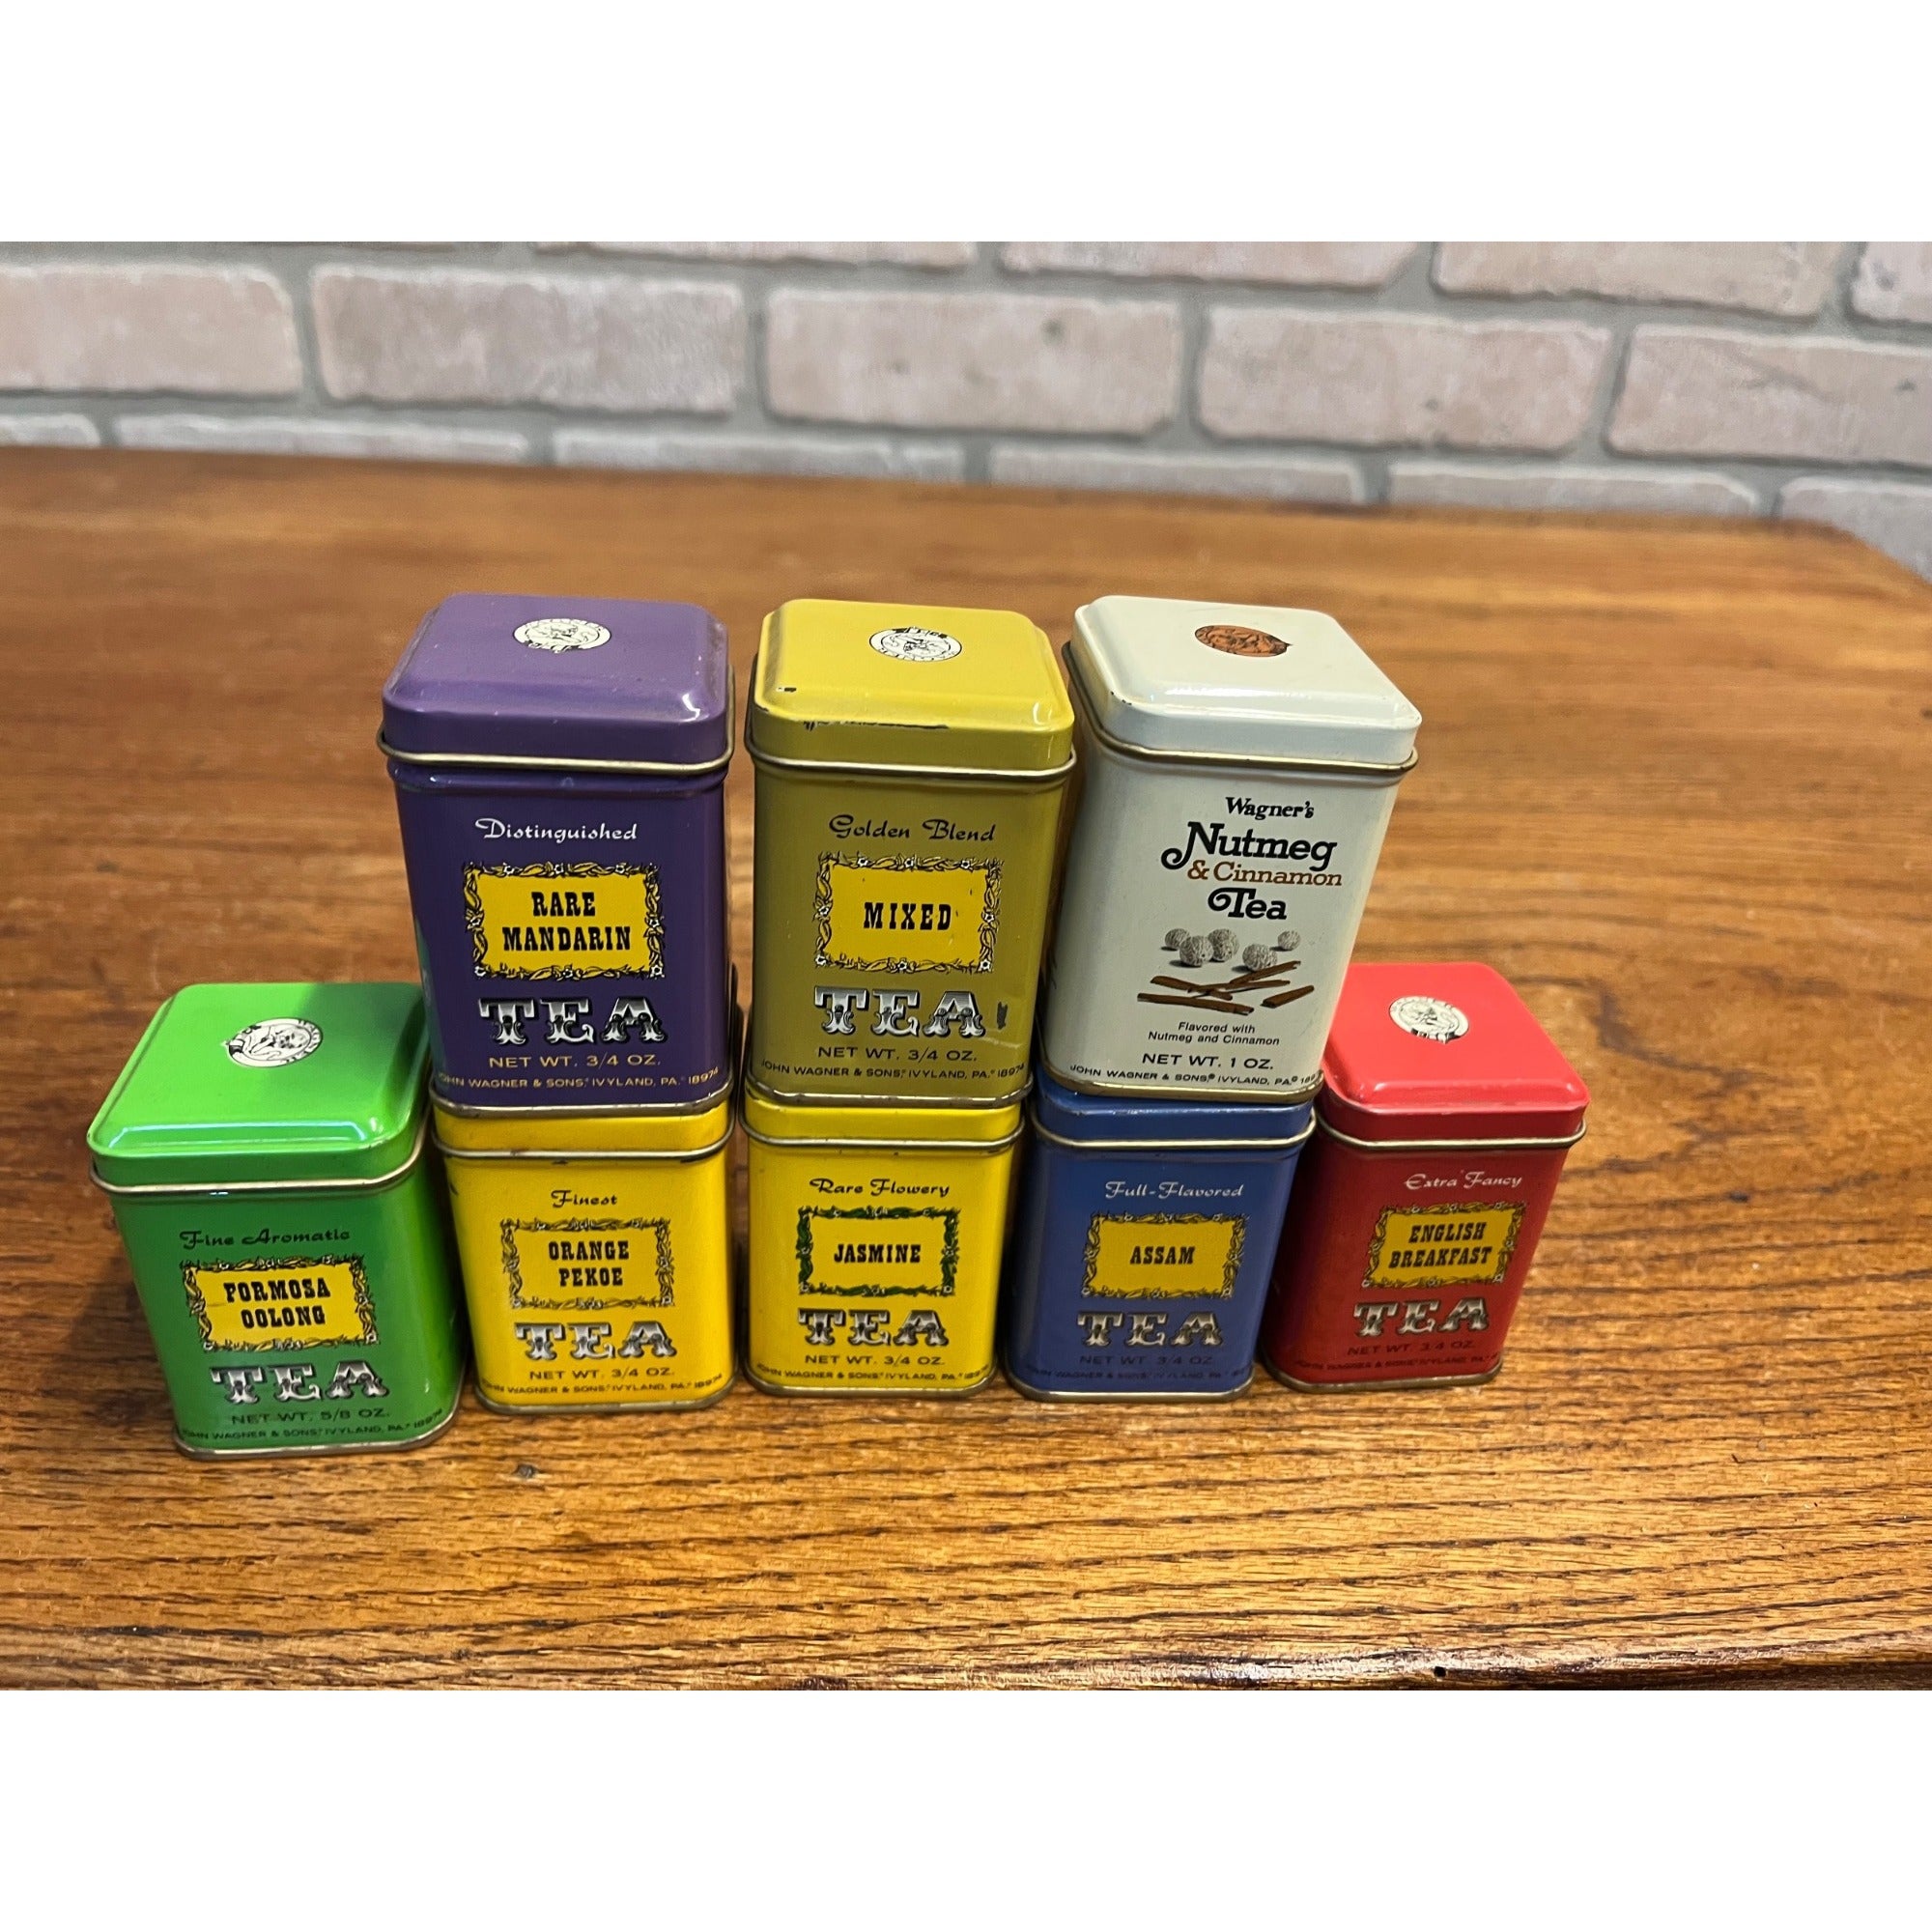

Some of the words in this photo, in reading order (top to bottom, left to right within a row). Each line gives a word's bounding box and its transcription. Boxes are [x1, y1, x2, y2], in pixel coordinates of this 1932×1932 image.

[1225, 797, 1315, 819] Wagner's
[475, 818, 637, 843] Distinguished
[829, 814, 910, 839] Golden
[922, 818, 996, 842] Blend
[1160, 821, 1337, 871] Nutmeg
[1186, 860, 1208, 880] &
[1213, 861, 1342, 886] Cinnamon
[531, 892, 596, 917] RARE
[1208, 887, 1288, 920] Tea
[863, 901, 952, 930] MIXED
[502, 926, 630, 952] MANDARIN
[478, 996, 667, 1045] TEA
[814, 984, 986, 1038] TEA
[1148, 1031, 1192, 1043] Nutmeg
[1198, 1035, 1218, 1043] and
[1223, 1035, 1279, 1045] Cinnamon
[1179, 1021, 1228, 1033] Flavored
[1233, 1024, 1255, 1034] with
[489, 1057, 531, 1068] NET
[540, 1055, 577, 1067] WT.
[586, 1051, 618, 1069] 3/4
[627, 1054, 661, 1066] OZ.
[817, 1046, 858, 1058] NET
[866, 1048, 899, 1060] WT.
[908, 1047, 938, 1063] 3/4
[947, 1050, 977, 1062] OZ.
[1142, 1053, 1182, 1065] NET
[1189, 1055, 1221, 1067] WT.
[1231, 1057, 1236, 1067] 1
[1243, 1058, 1273, 1069] OZ.
[793, 1066, 849, 1077] WAGNER
[854, 1067, 862, 1076] &
[1069, 1064, 1101, 1077] JOHN
[1106, 1070, 1158, 1080] WAGNER
[469, 1078, 527, 1089] WAGNER
[533, 1079, 541, 1088] &
[810, 1178, 864, 1195] Rare
[869, 1179, 950, 1197] Flowery
[1105, 1181, 1244, 1199] Full-Flavored
[1404, 1174, 1457, 1190] Extra
[1463, 1171, 1522, 1189] Fancy
[551, 1189, 618, 1208] Finest
[180, 1231, 234, 1250] Fine
[242, 1228, 350, 1246] Aromatic
[1408, 1222, 1487, 1243] ENGLISH
[548, 1240, 630, 1261] ORANGE
[834, 1244, 921, 1264] JASMINE
[1130, 1246, 1195, 1264] ASSAM
[1389, 1247, 1492, 1268] BREAKFAST
[558, 1266, 623, 1287] PEKOE
[223, 1277, 331, 1303] FORMOSA
[241, 1305, 326, 1329] OOLONG
[798, 1308, 949, 1347] TEA
[1353, 1297, 1489, 1337] TEA
[1077, 1311, 1223, 1347] TEA
[514, 1321, 677, 1360] TEA
[1348, 1346, 1380, 1355] NET
[1422, 1342, 1444, 1351] 34
[805, 1354, 839, 1364] NET
[884, 1354, 910, 1367] 3/4
[1080, 1355, 1114, 1365] NET
[210, 1360, 389, 1405] TEA
[529, 1371, 565, 1380] NET
[611, 1366, 639, 1378] 3/4
[783, 1370, 833, 1378] WAGNER
[508, 1384, 558, 1393] WAGNER
[232, 1413, 270, 1425] NET
[320, 1408, 351, 1422] 5/8
[357, 1407, 389, 1418] OZ.
[213, 1430, 266, 1439] WAGNER
